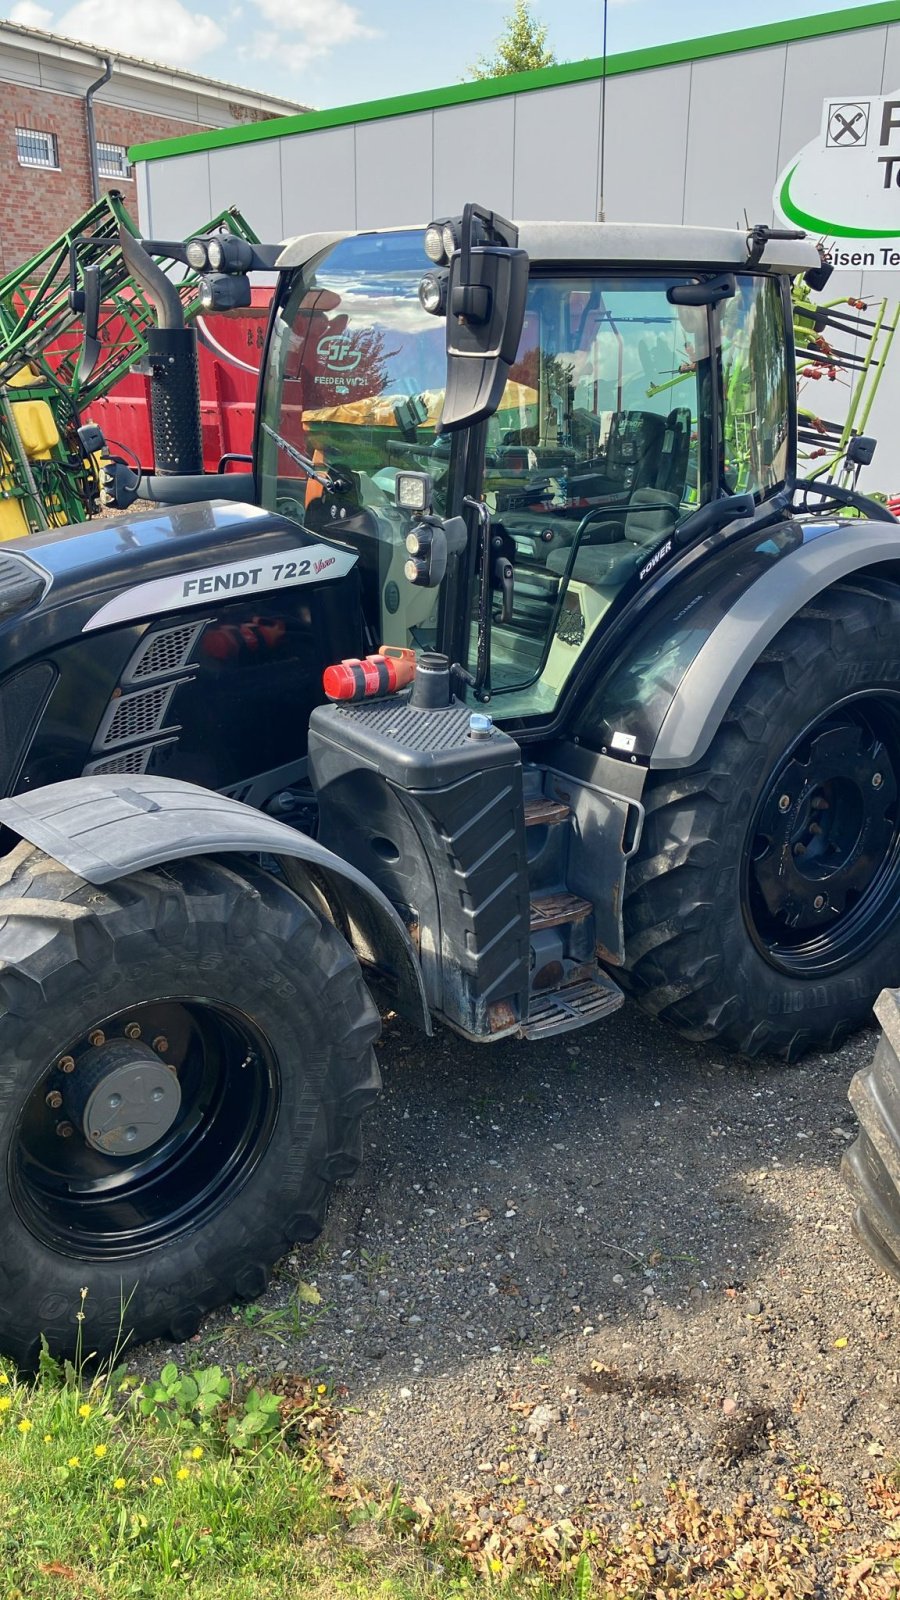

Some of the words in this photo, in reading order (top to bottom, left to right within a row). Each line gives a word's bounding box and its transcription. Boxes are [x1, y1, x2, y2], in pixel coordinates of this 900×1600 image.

[314, 376, 345, 385] FEEDER
[182, 568, 263, 598] FENDT
[272, 559, 311, 582] 722
[639, 540, 673, 580] POWER
